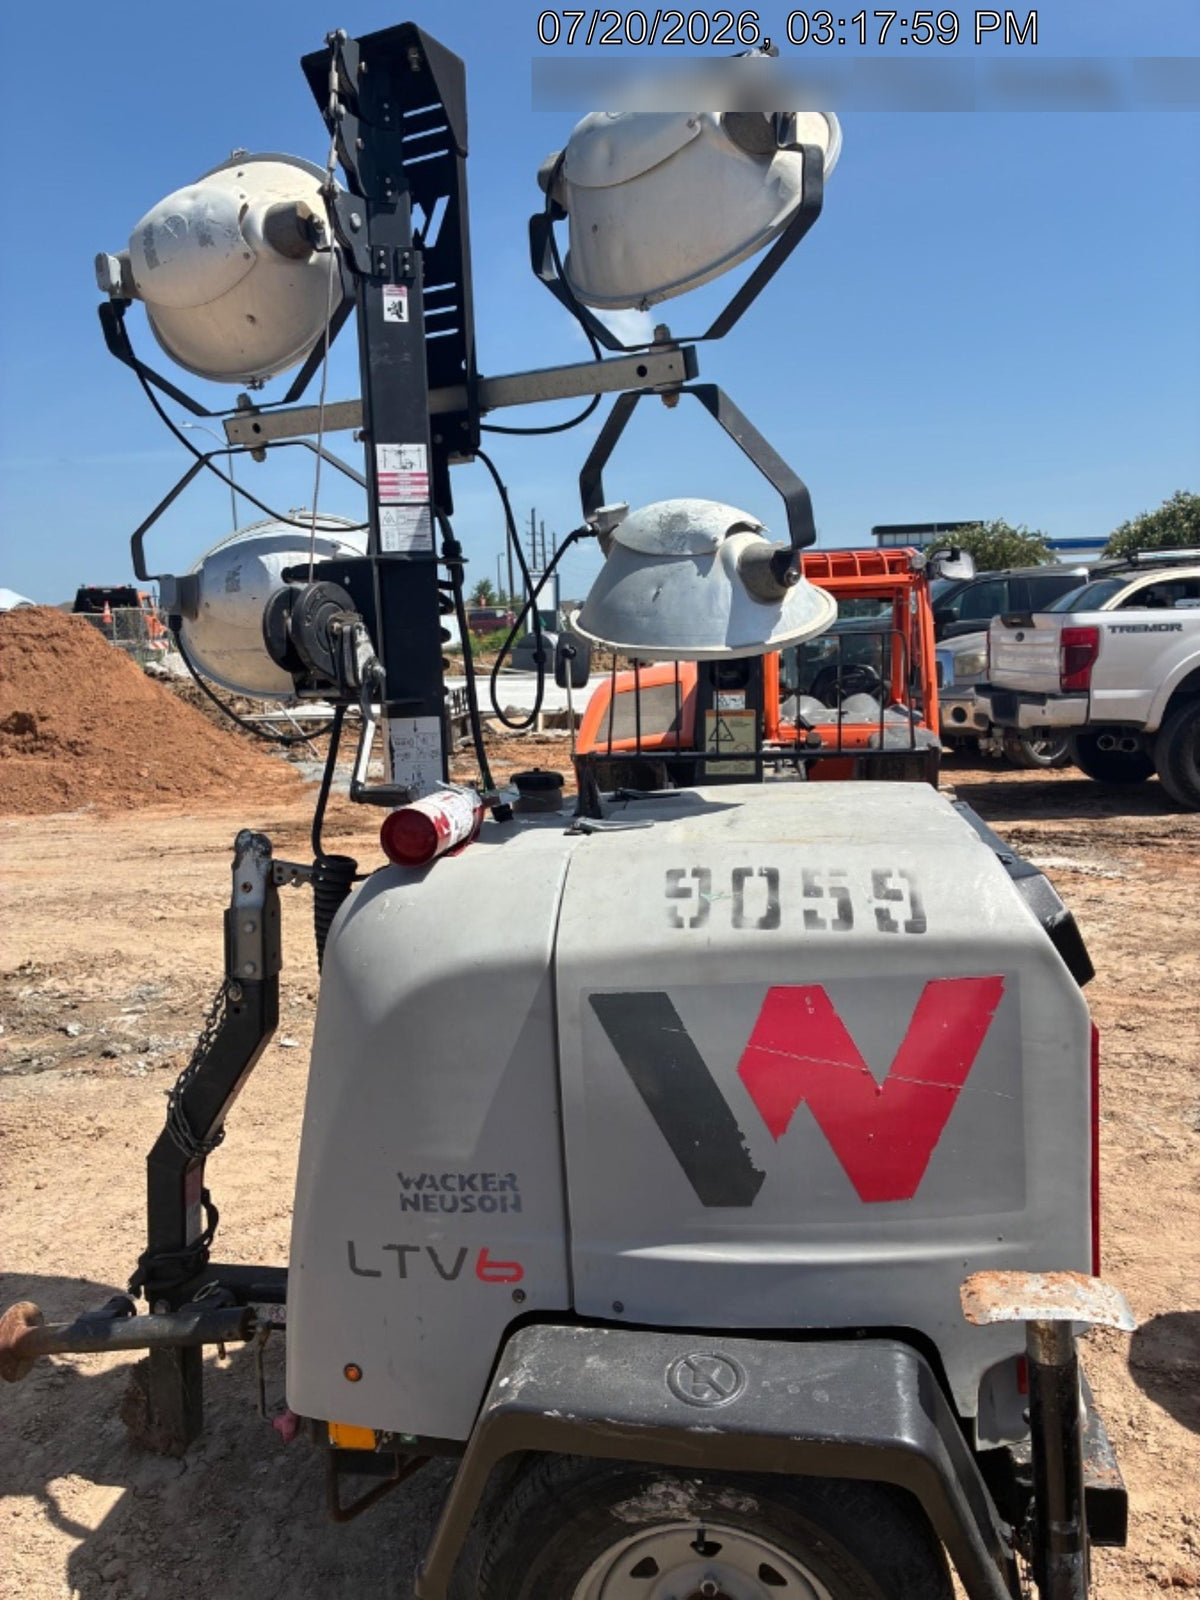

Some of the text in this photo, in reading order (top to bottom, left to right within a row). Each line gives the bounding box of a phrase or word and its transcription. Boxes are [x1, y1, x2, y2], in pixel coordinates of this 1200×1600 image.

[1107, 623, 1183, 634] TREMOR
[397, 1171, 520, 1192] WACKER
[400, 1192, 523, 1213] NEUSON
[347, 1239, 525, 1283] LTV6
